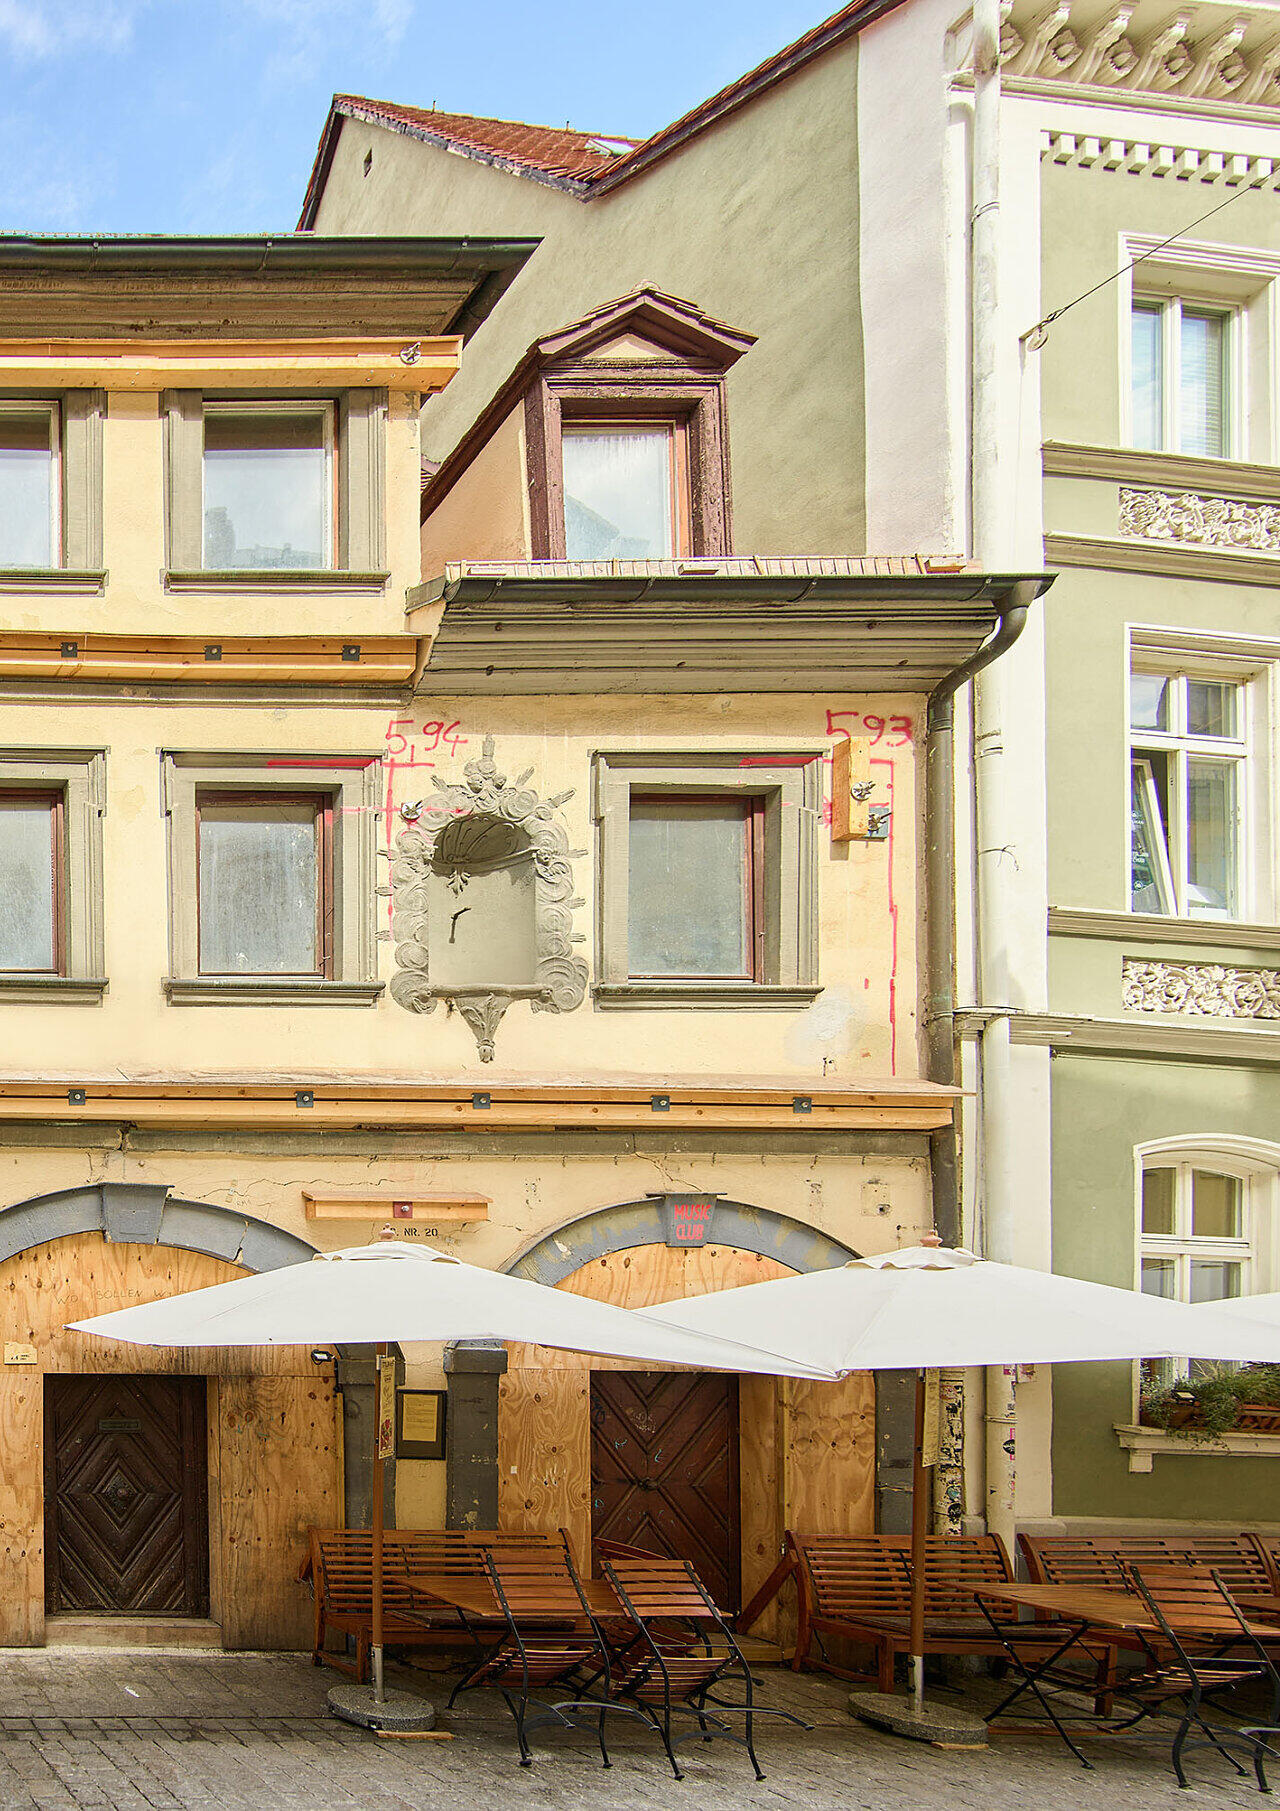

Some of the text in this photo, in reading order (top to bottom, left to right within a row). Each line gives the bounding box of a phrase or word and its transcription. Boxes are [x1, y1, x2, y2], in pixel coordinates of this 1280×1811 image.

[385, 720, 468, 762] 5,94
[674, 1204, 712, 1221] MUSIC
[425, 1228, 438, 1237] 20
[676, 1224, 704, 1240] CLUB
[96, 1289, 143, 1300] SOLLEN
